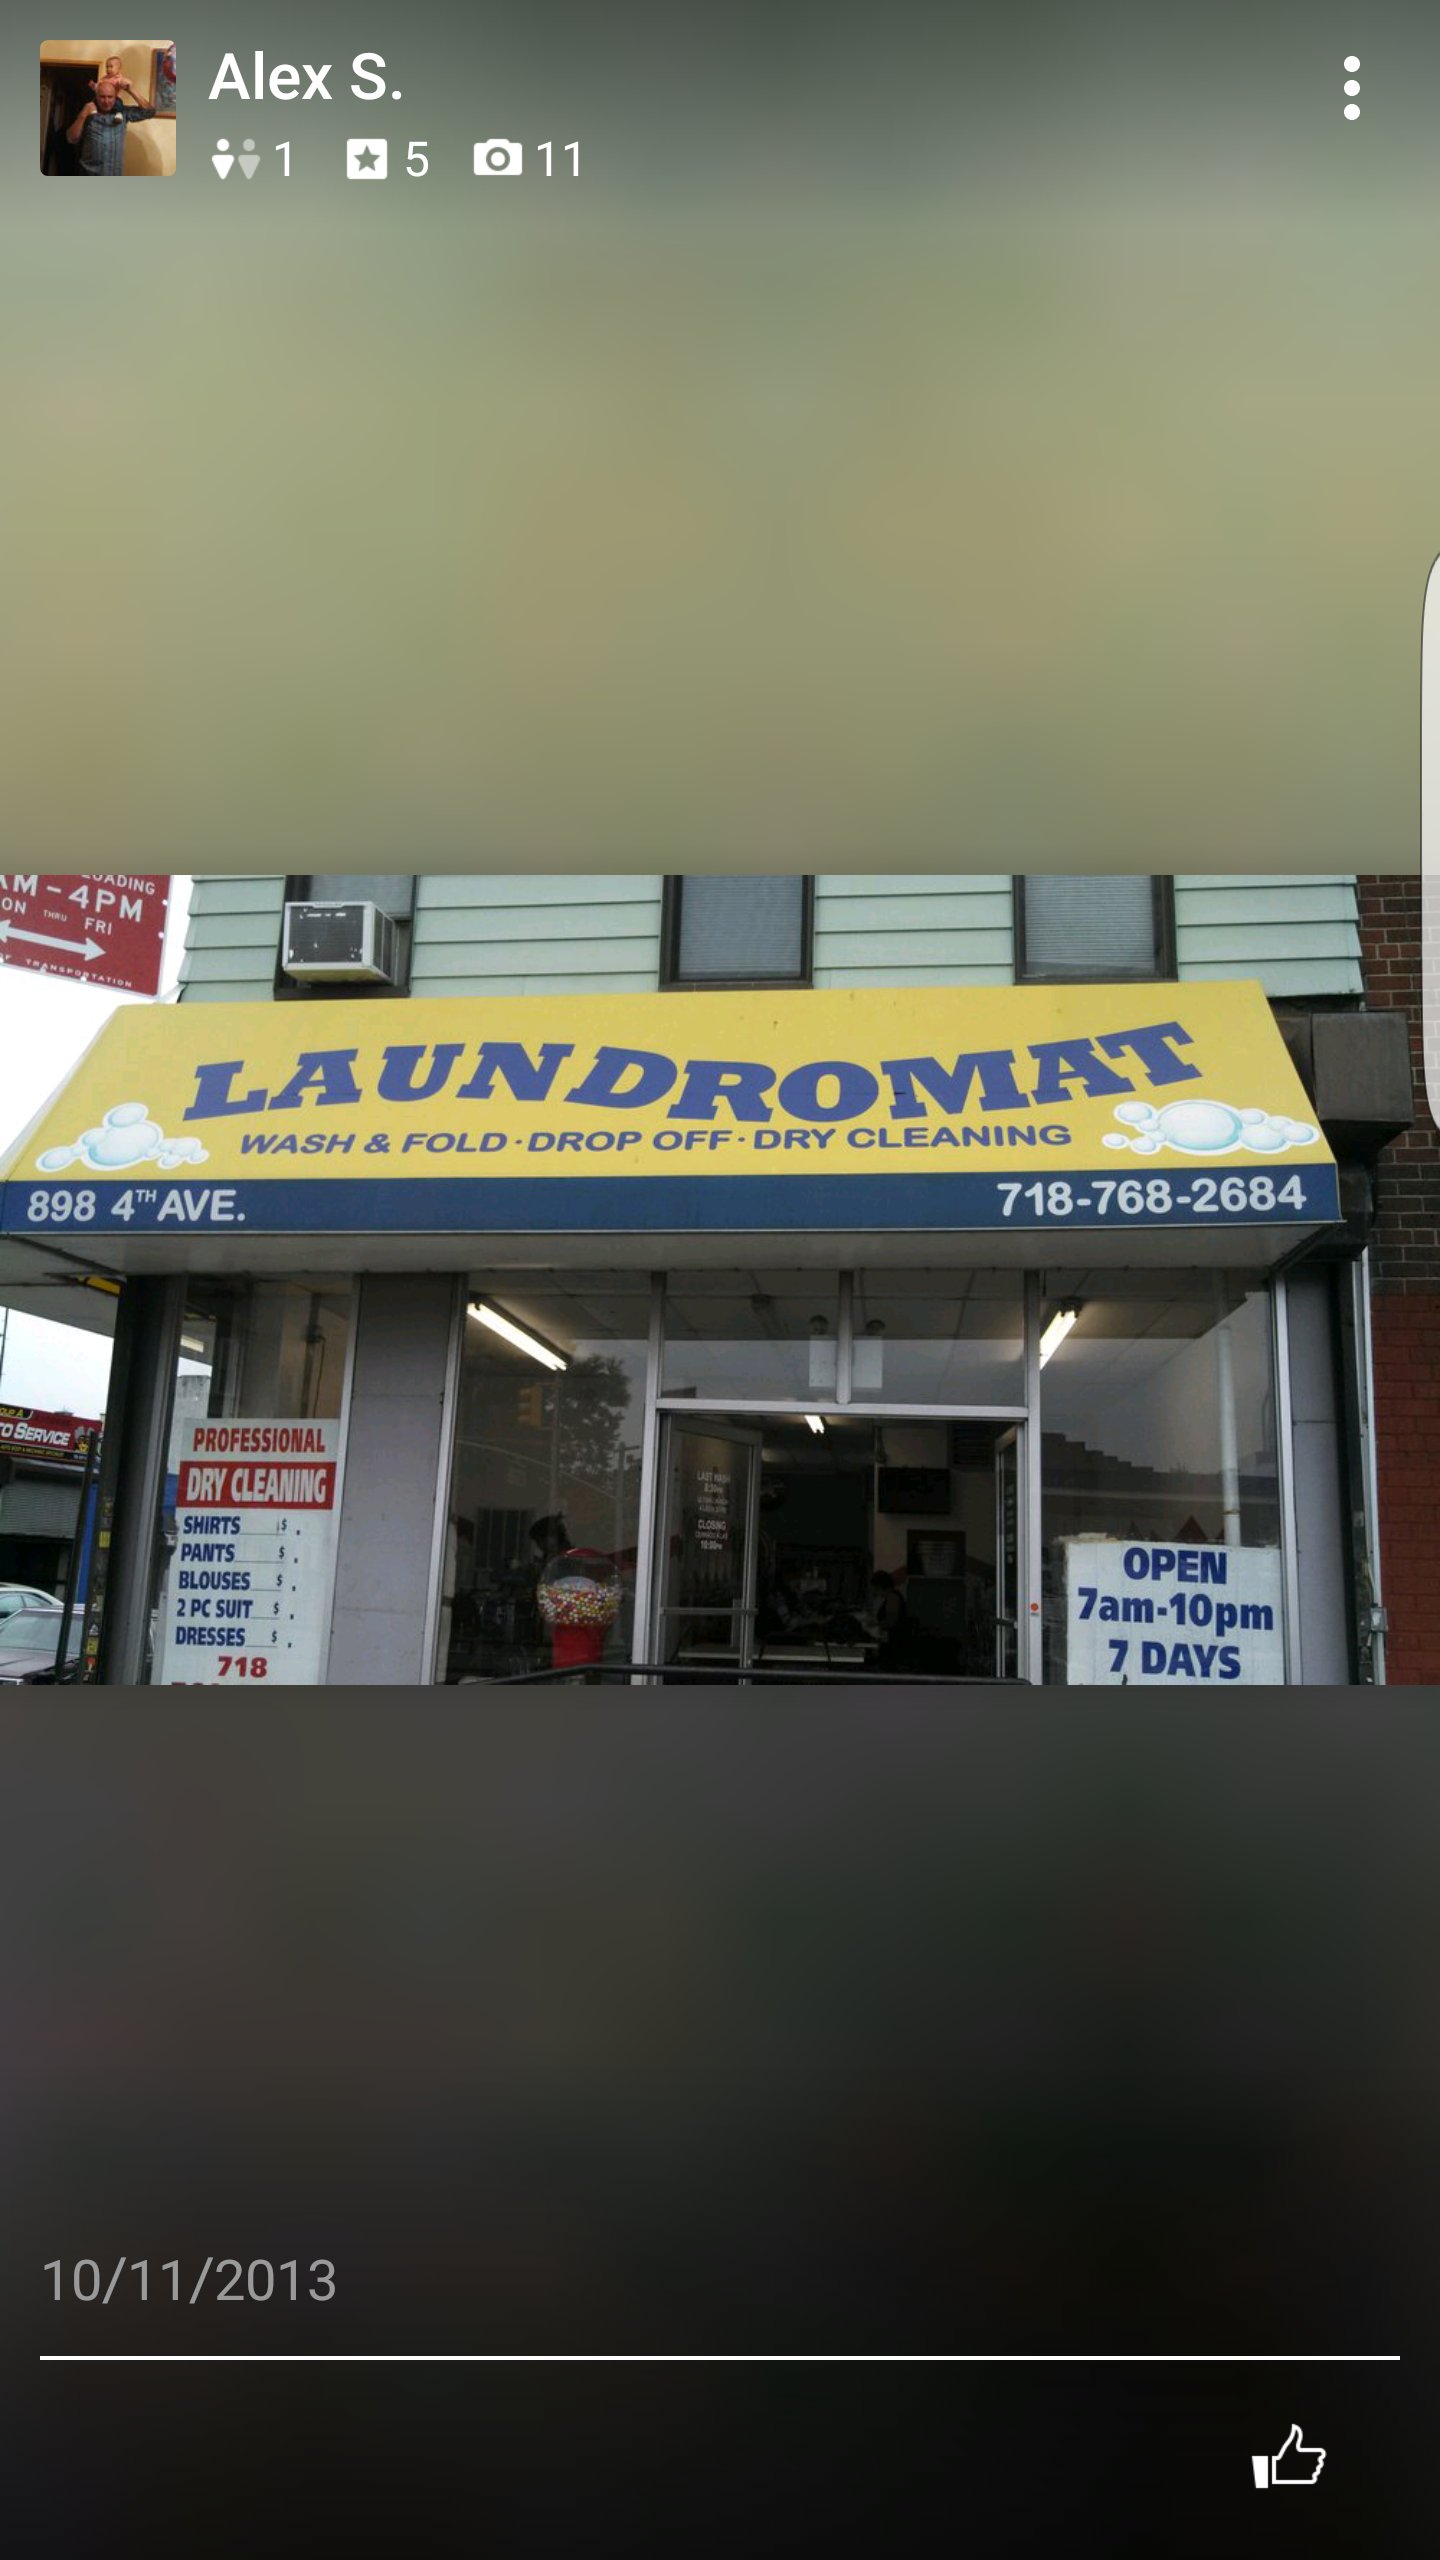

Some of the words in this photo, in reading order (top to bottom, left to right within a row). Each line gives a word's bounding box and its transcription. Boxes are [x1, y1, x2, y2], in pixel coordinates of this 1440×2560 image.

[81, 874, 156, 895] OADING
[43, 909, 68, 922] THRU
[84, 916, 113, 936] FRI
[25, 958, 132, 988] TRANSPORTATION
[183, 1021, 1204, 1122] LAUNDROMAT
[240, 1134, 356, 1155] WASH
[363, 1133, 390, 1154] &
[402, 1132, 508, 1154] FOLD
[527, 1131, 643, 1153] DROP
[653, 1130, 731, 1151] OFF
[754, 1128, 837, 1150] DRY
[847, 1125, 1072, 1150] CLEANING
[27, 1190, 97, 1222] 898
[157, 1189, 246, 1222] AVE.
[996, 1174, 1308, 1217] 718-768-2684
[14, 1421, 71, 1446] SERVICE
[192, 1427, 326, 1453] PROFESSIONAL
[186, 1467, 227, 1502] DRY
[231, 1468, 327, 1504] CLEANING
[183, 1515, 241, 1536] SHIRTS
[697, 1518, 727, 1531] CLOSING
[181, 1543, 235, 1563] PANTS
[1123, 1547, 1228, 1585] OPEN
[178, 1571, 251, 1591] BLOUSES
[176, 1598, 186, 1617] 2
[190, 1598, 211, 1618] PC
[215, 1598, 253, 1619] SUIT
[1078, 1587, 1274, 1638] 7am-10pm
[175, 1626, 246, 1647] DRESSES
[218, 1655, 267, 1678] 718
[1108, 1639, 1130, 1673] 7
[1141, 1640, 1241, 1680] DAYS
